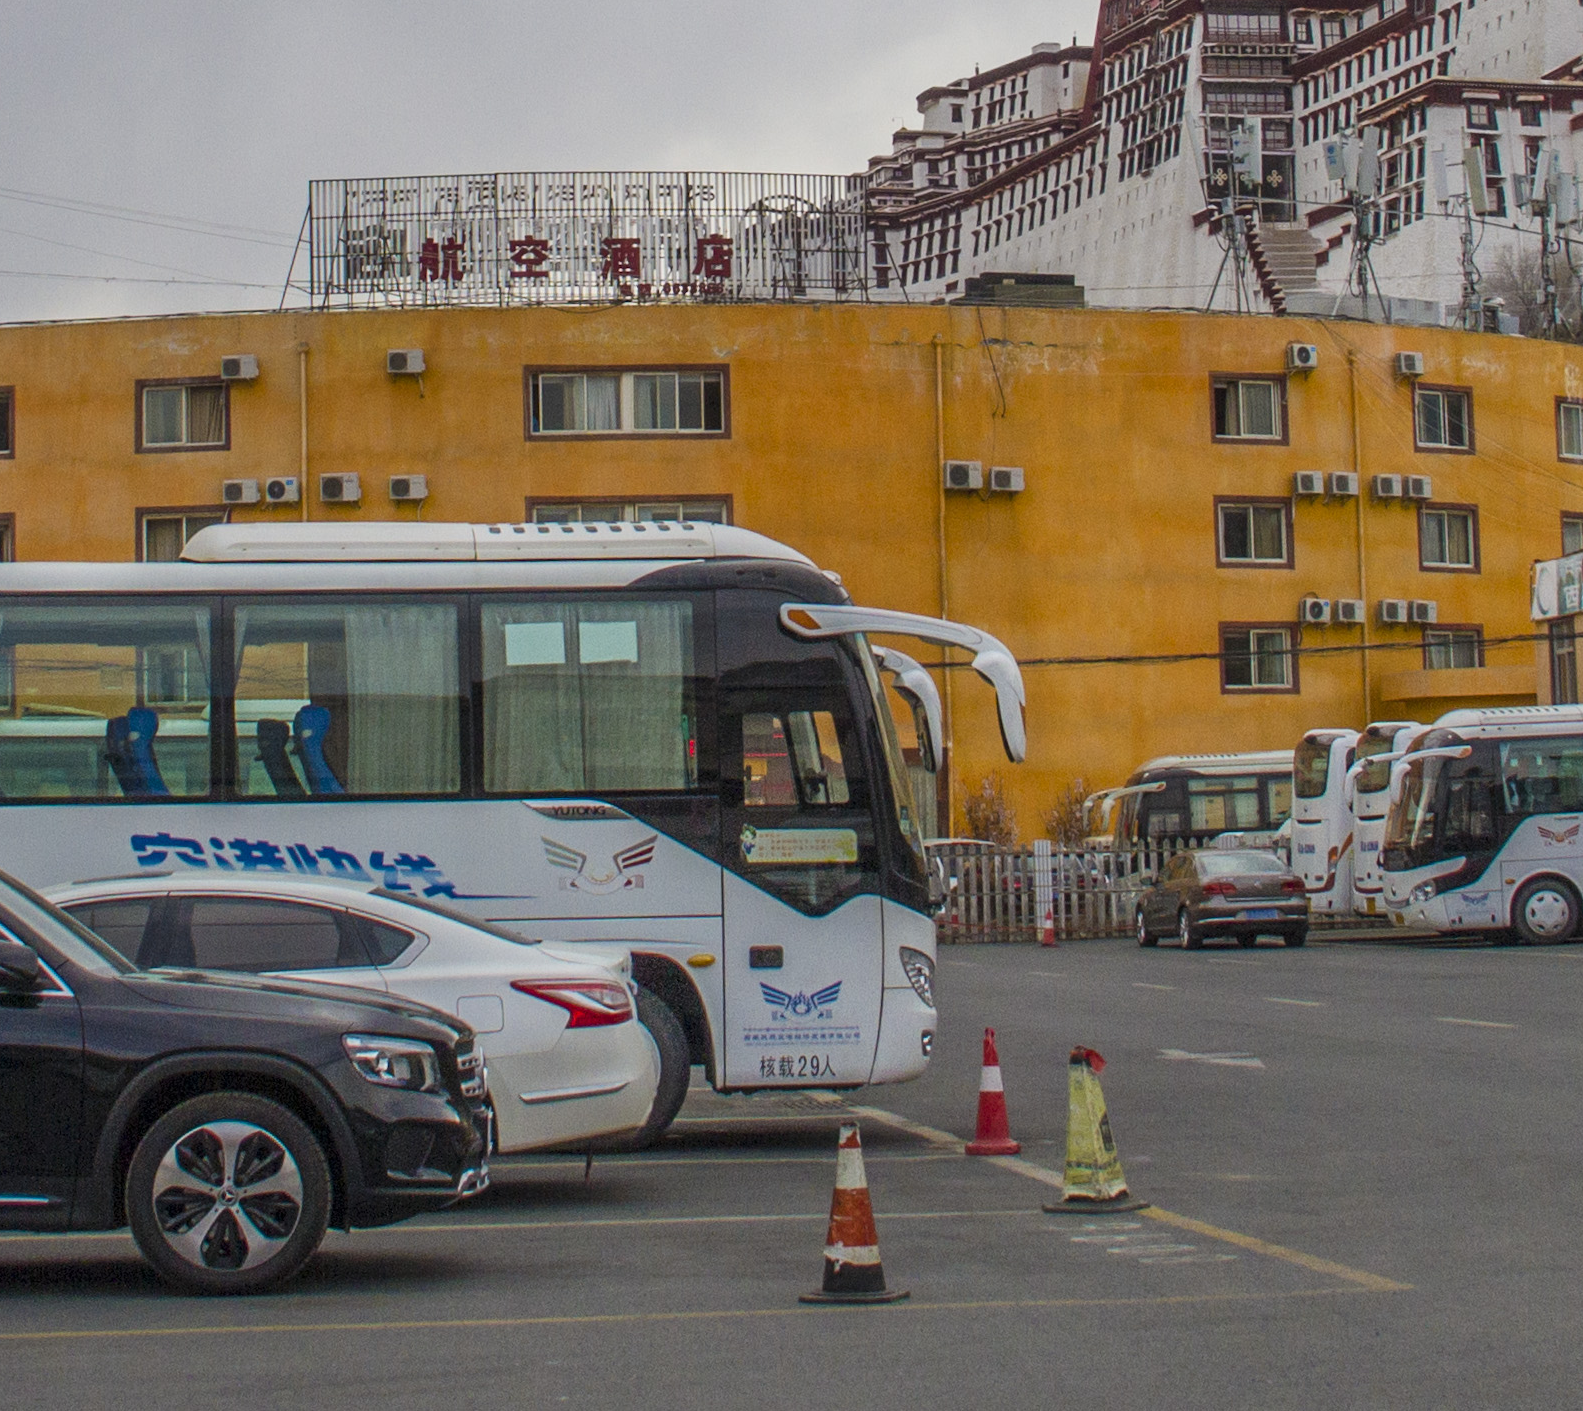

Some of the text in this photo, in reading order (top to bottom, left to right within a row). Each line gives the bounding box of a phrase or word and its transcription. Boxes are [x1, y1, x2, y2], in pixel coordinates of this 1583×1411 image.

[419, 234, 734, 281] 航空酒店
[552, 805, 607, 816] YUTONG
[759, 1055, 836, 1078] 核载29人
